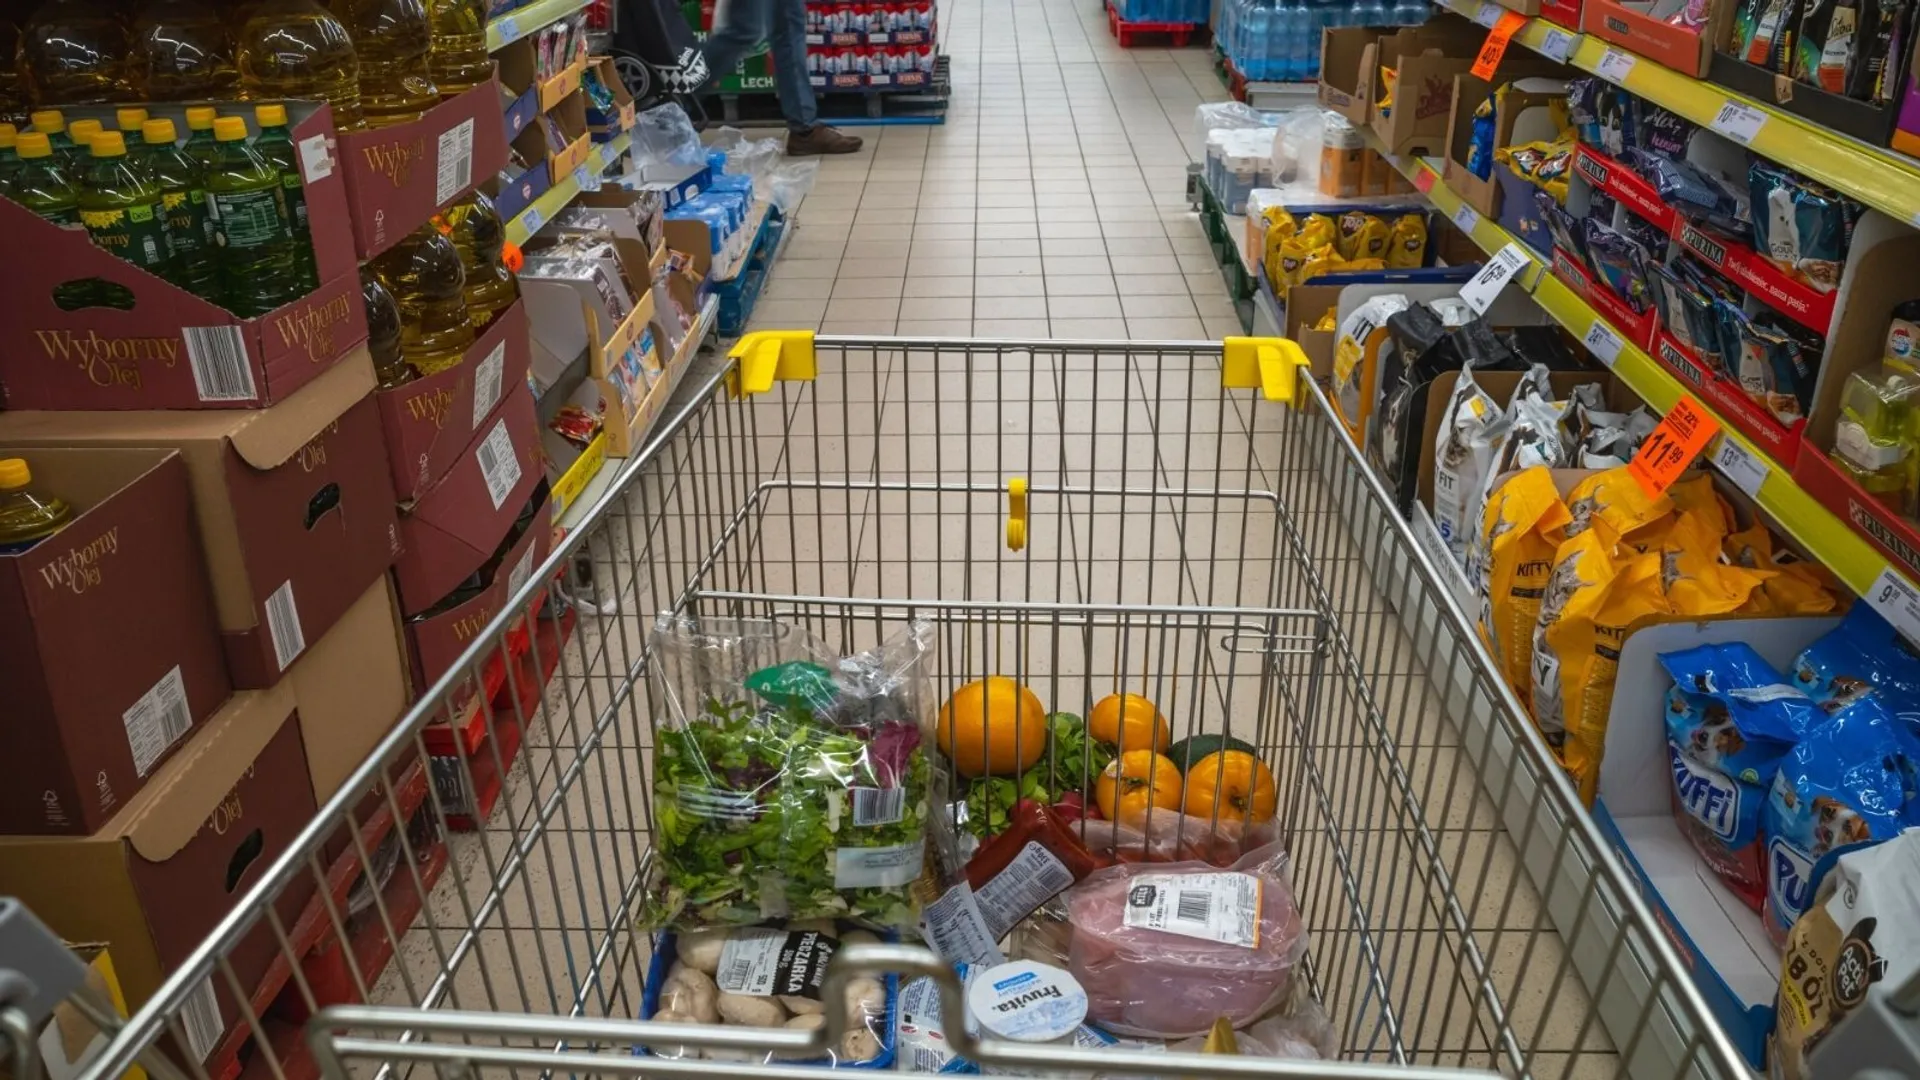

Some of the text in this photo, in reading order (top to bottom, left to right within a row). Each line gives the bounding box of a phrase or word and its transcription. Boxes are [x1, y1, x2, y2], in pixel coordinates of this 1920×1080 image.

[741, 77, 774, 88] LECH
[1688, 228, 1723, 265] PURINA
[36, 329, 180, 367] Wyborny
[1668, 346, 1700, 386] PURINA
[88, 353, 141, 389] Olej
[301, 444, 327, 472] Olej
[1438, 470, 1455, 491] FIT
[39, 525, 119, 590] Wyborny
[1864, 514, 1920, 570] PURINA
[71, 564, 102, 595] Olej
[1516, 560, 1554, 577] KITTY
[1594, 625, 1624, 642] KIT
[212, 794, 244, 835] Olej
[788, 931, 804, 993] PIECZARKA
